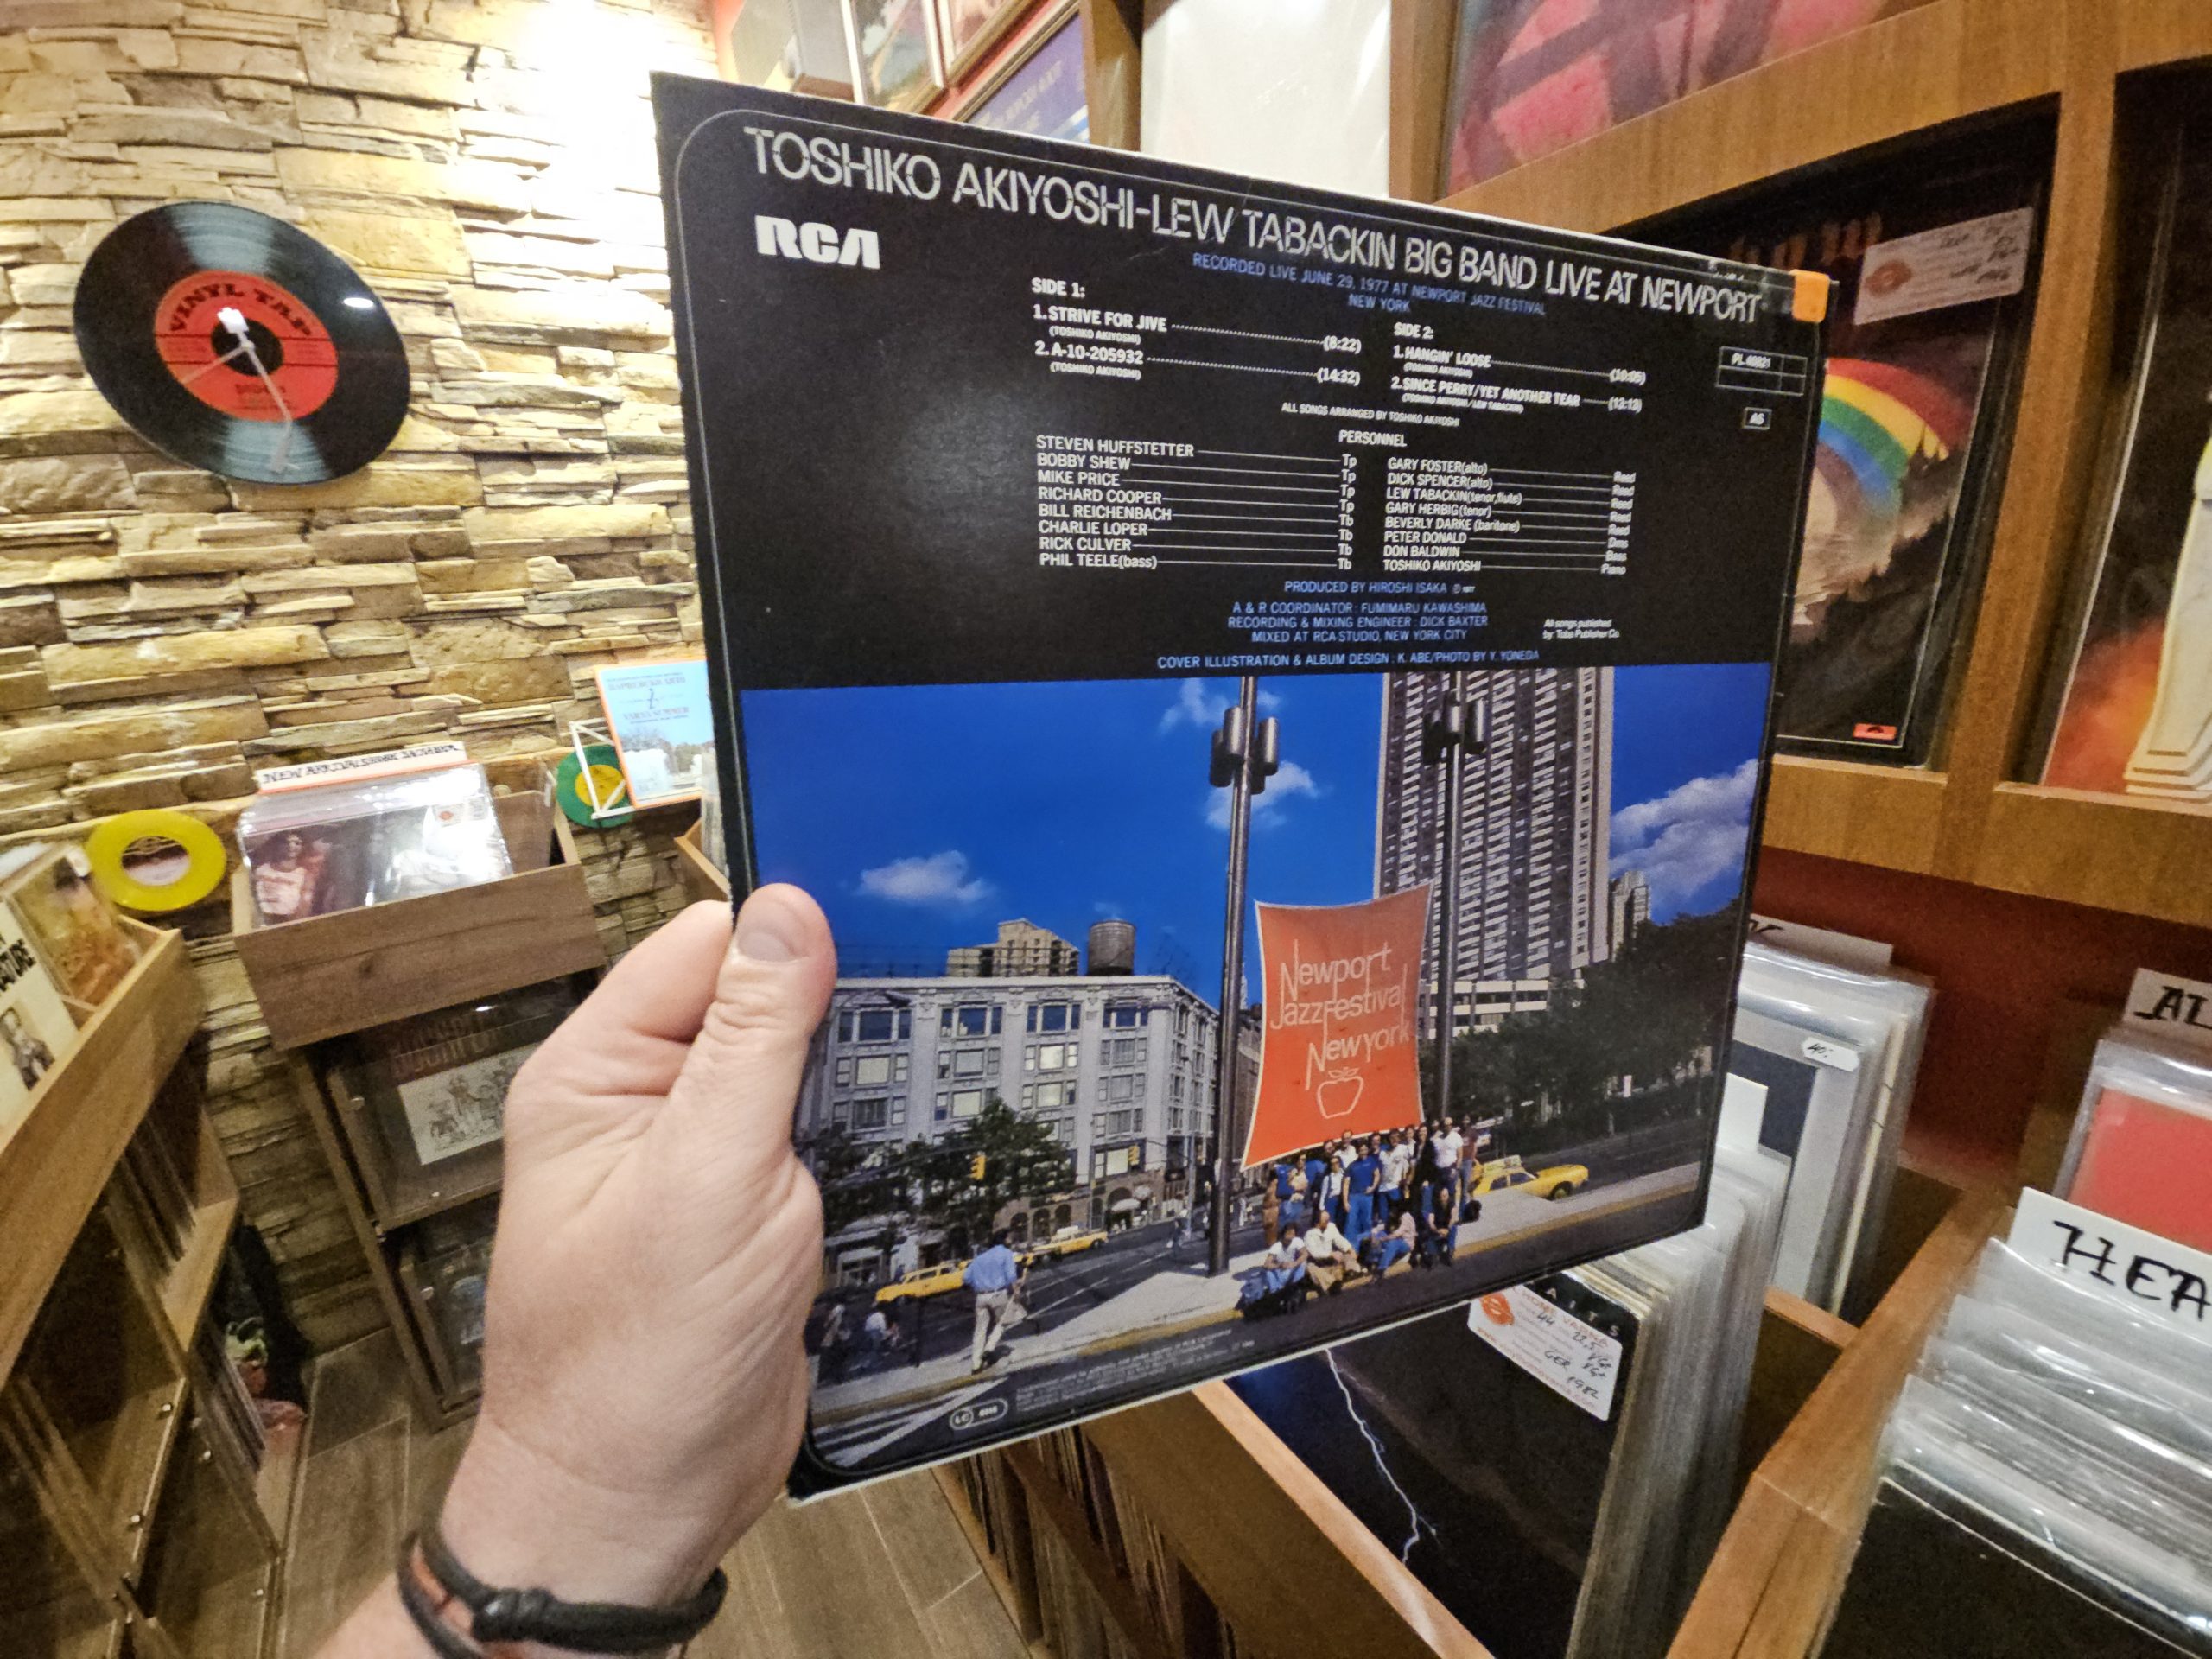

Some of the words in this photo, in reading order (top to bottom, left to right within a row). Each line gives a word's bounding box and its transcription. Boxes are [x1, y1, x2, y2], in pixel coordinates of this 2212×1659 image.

[743, 127, 941, 200] TOSHIKO
[953, 162, 1236, 243] AKIYOSHI-LEW
[1243, 208, 1396, 270] TABACKIN
[1404, 238, 1453, 275] BIG
[1459, 247, 1536, 290] BAND
[1544, 262, 1603, 302] LIVE
[1605, 273, 1635, 302] AT
[1640, 279, 1763, 323] NEWPORT
[754, 215, 880, 269] RCA
[1032, 277, 1067, 296] SIDE
[1071, 282, 1085, 298] 1:
[1192, 253, 1266, 276] RECORDED
[1269, 265, 1297, 281] LIVE
[1300, 270, 1333, 286] JUNE
[1336, 274, 1356, 289] 29,
[1360, 277, 1389, 293] 1977
[1391, 283, 1408, 296] AT
[1411, 284, 1468, 303] NEWPORT
[1470, 294, 1497, 309] JAZZ
[1498, 298, 1547, 316] FESTIVAL
[170, 283, 245, 331] VINYL
[254, 288, 311, 335] TAP
[1348, 293, 1377, 309] NEW
[1381, 296, 1410, 312] YORK
[1104, 311, 1134, 329] FOR
[1136, 315, 1167, 333] JIVE
[1323, 335, 1362, 355] (8:22)
[1394, 321, 1421, 338] SIDE
[1422, 326, 1434, 340] 2:
[1455, 352, 1491, 368] LOOSE
[1316, 367, 1361, 387] (14:32)
[1402, 377, 1437, 393] SINCE
[1501, 387, 1553, 404] ANOTHER
[1554, 392, 1581, 407] TEAR
[1281, 402, 1298, 413] ALL
[1300, 404, 1328, 416] SONGS
[1329, 406, 1374, 419] ARRANGED
[1375, 410, 1388, 421] BY
[1389, 411, 1423, 423] TOSHIKO
[1423, 415, 1460, 427] AKIYOSHI
[1338, 429, 1408, 448] PERSONNEL
[1036, 435, 1094, 453] STEVEN
[1097, 437, 1194, 457] HUFFSTETTER
[1342, 453, 1357, 469] Tp
[1037, 453, 1085, 468] BOBBY
[1090, 455, 1131, 470] SHEW
[1341, 469, 1357, 484] Tp
[1388, 456, 1419, 470] GARY
[1037, 470, 1074, 485] MIKE
[1078, 471, 1120, 486] PRICE
[1340, 484, 1355, 499] Tp
[1387, 473, 1414, 486] DICK
[1038, 486, 1103, 503] RICHARD
[1106, 490, 1162, 505] COOPER
[1339, 499, 1355, 514] Tp
[1386, 487, 1410, 499] LEW
[1038, 503, 1069, 518] BILL
[1073, 505, 1173, 521] REICHENBACH
[1338, 514, 1354, 528] Tb
[1385, 502, 1416, 514] GARY
[1038, 520, 1100, 535] CHARLIE
[1103, 521, 1148, 536] LOPER
[1338, 528, 1353, 543] Tb
[1384, 517, 1433, 530] BEVERLY
[1435, 518, 1471, 531] DARKE
[1039, 537, 1073, 551] RICK
[1077, 537, 1132, 552] CULVER
[1338, 543, 1353, 556] Tb
[1383, 531, 1420, 543] PETER
[1421, 532, 1467, 544] DONALD
[1383, 545, 1408, 557] DON
[1410, 546, 1460, 557] BALDWIN
[1039, 553, 1073, 567] PHIL
[1337, 557, 1352, 571] Tb
[1382, 559, 1431, 571] TOSHIKO
[1432, 561, 1481, 572] AKIYOSHI
[1284, 580, 1349, 594] PRODUCED
[1351, 582, 1366, 594] BY
[1369, 582, 1413, 594] HIROSHI
[1416, 582, 1447, 594] ISAKA
[1232, 601, 1242, 613] A
[1245, 601, 1255, 613] &
[1361, 602, 1420, 613] FUMIMARU
[1423, 602, 1487, 613] KAWASHIMA
[1228, 616, 1297, 628] RECORDING
[1300, 616, 1309, 628] &
[1313, 616, 1353, 628] MIXING
[1357, 616, 1411, 628] ENGINEER
[1420, 616, 1445, 627] DICK
[1447, 615, 1488, 627] BAXTER
[1251, 630, 1290, 642] MIXED
[1294, 630, 1309, 642] AT
[1384, 629, 1409, 641] NEW
[1414, 629, 1440, 641] YORK
[1444, 629, 1467, 640] CITY
[1158, 656, 1199, 669] COVER
[1205, 654, 1289, 668] ILLUSTRATION
[1293, 654, 1301, 666] &
[1306, 653, 1345, 666] ALBUM
[1349, 652, 1389, 664] DESIGN
[1410, 652, 1471, 664] ABE/PHOTO
[1473, 652, 1486, 663] BY
[1501, 650, 1540, 661] YONEDA
[264, 766, 302, 784] NEW
[1281, 938, 1392, 1002] Newport
[2053, 1219, 2212, 1321] HEA
